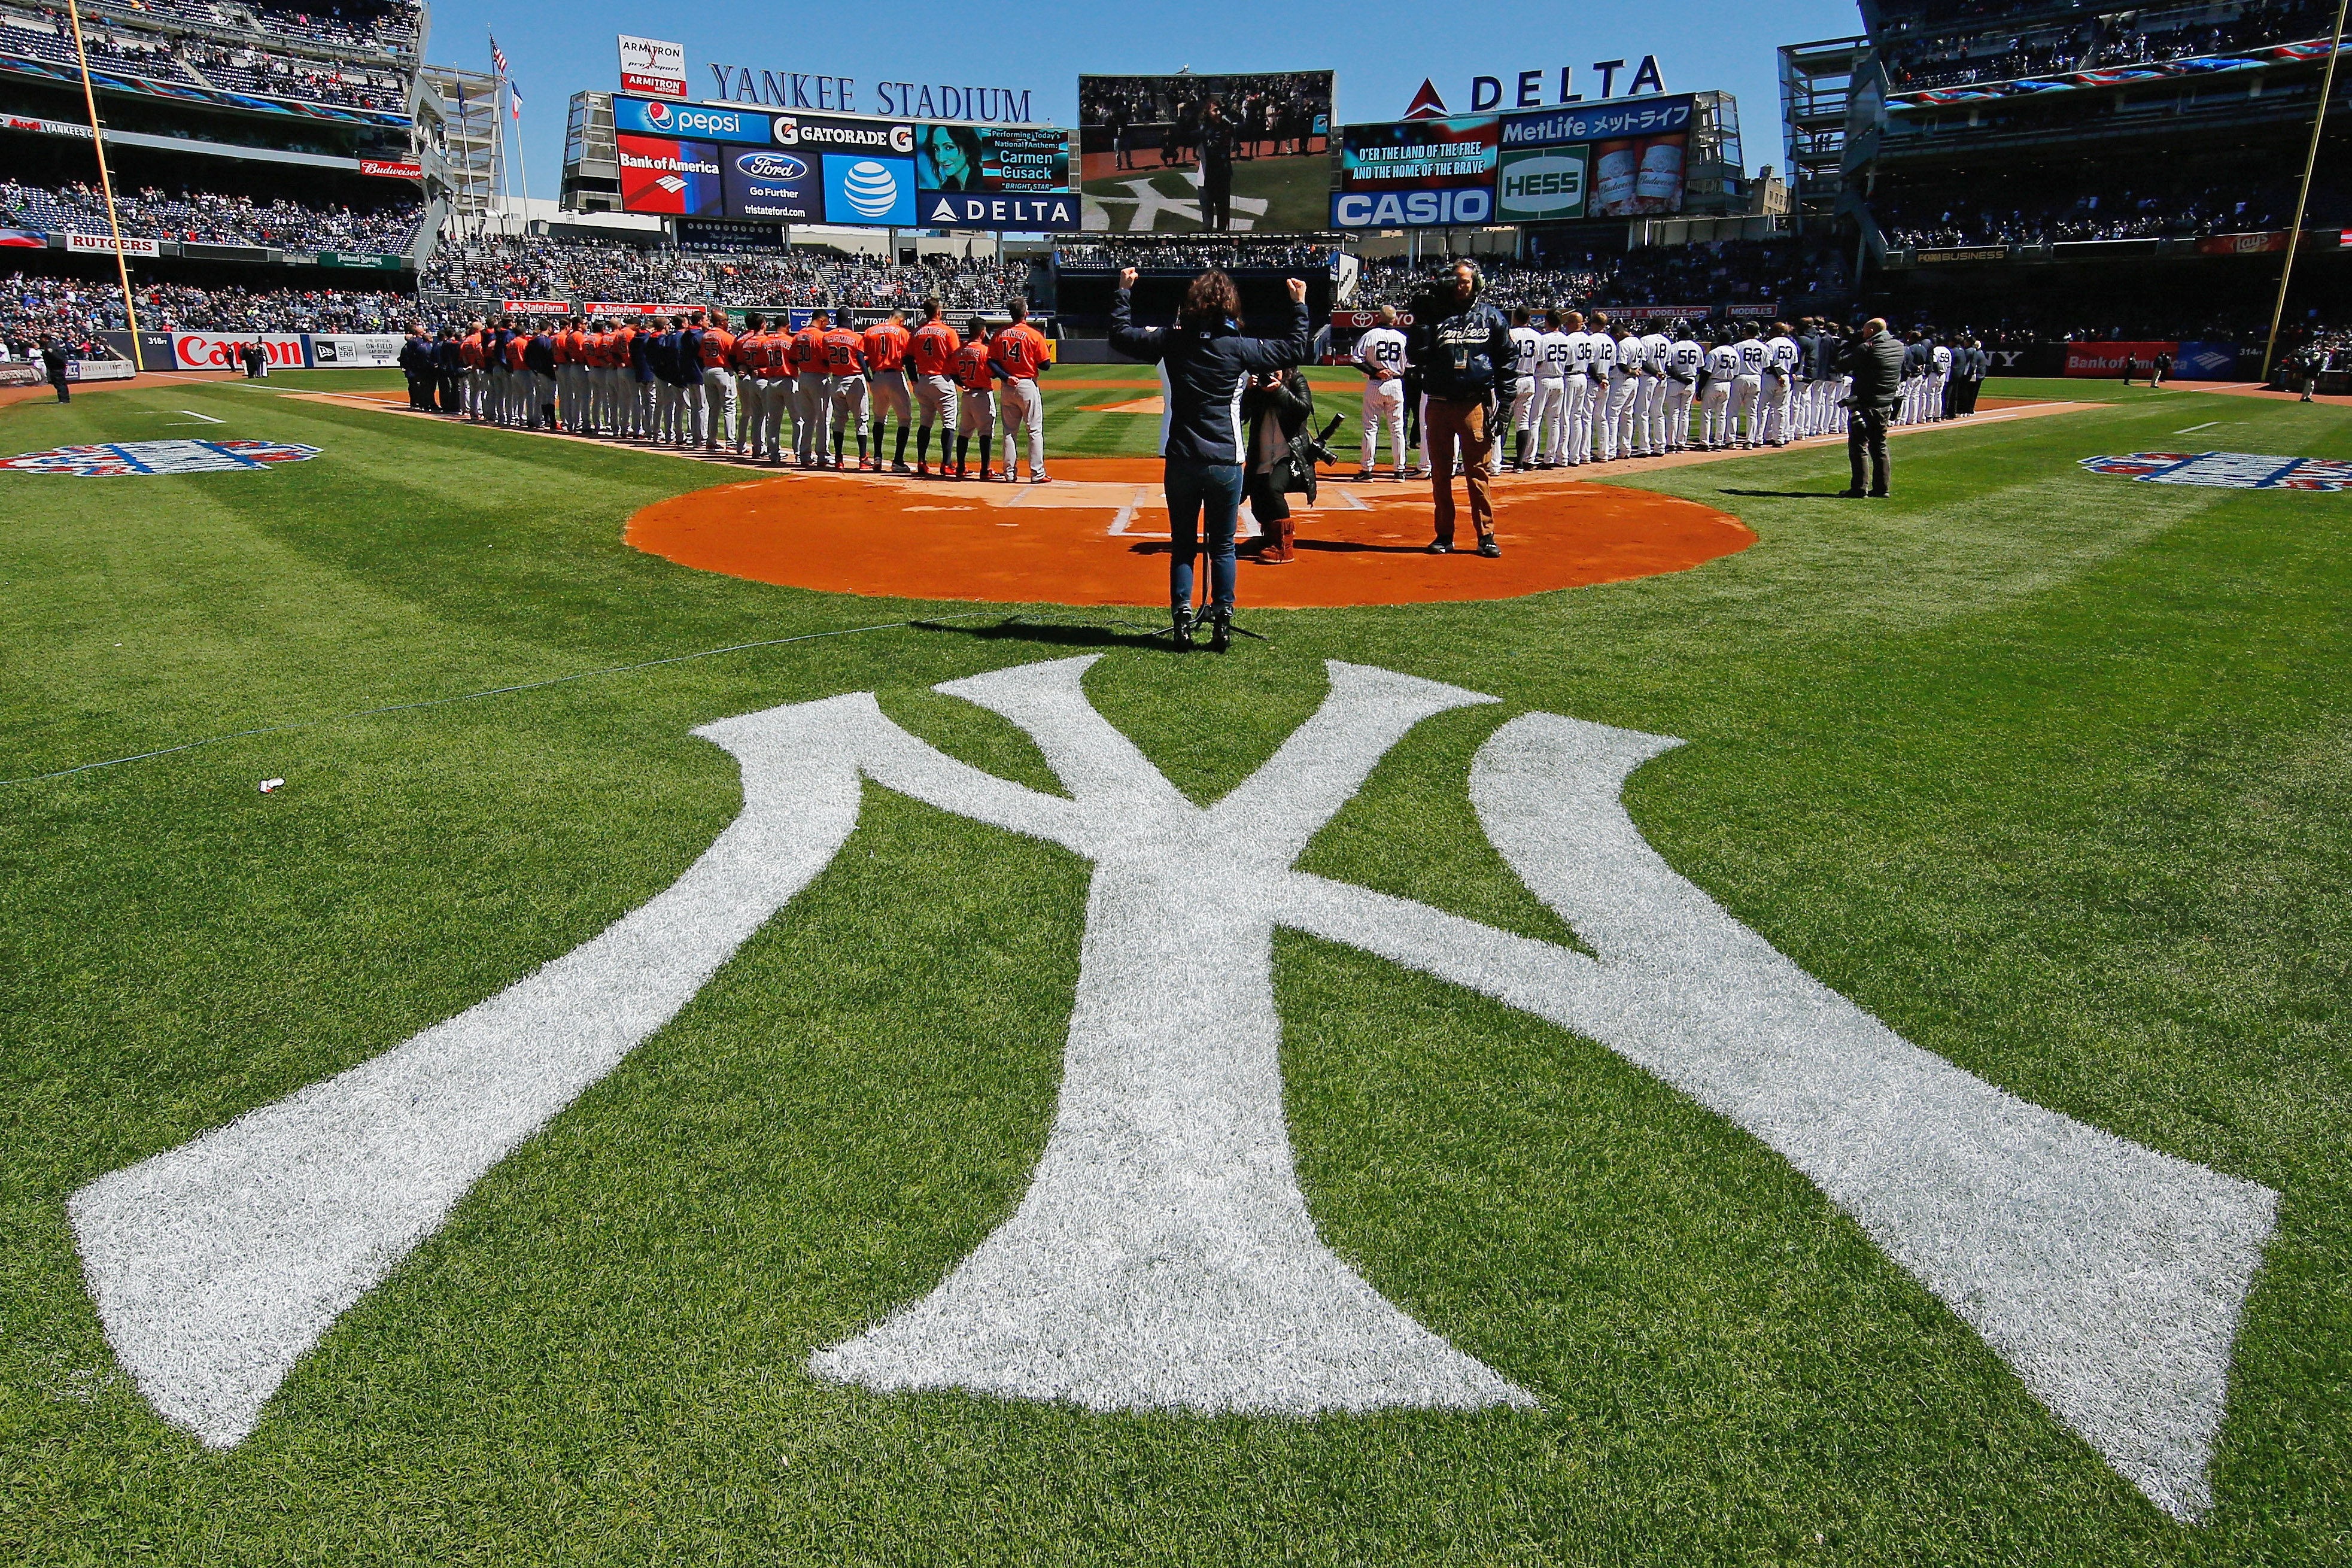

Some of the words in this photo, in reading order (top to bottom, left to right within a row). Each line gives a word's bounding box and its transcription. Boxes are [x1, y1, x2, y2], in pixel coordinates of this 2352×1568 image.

[623, 42, 680, 57] ARMITRON
[628, 75, 680, 89] ARMITRON
[1471, 54, 1666, 112] DELTA
[707, 63, 856, 112] YANKEE
[877, 81, 1031, 123] STADIUM
[9, 118, 42, 130] Audi
[44, 122, 85, 136] YANKEES
[87, 128, 110, 140] CUB
[678, 112, 740, 135] pepsi
[1502, 116, 1587, 142] MetLife
[1593, 106, 1689, 134] メットライフ
[800, 127, 887, 145] GATORADE
[992, 130, 1031, 139] Performing
[1034, 132, 1060, 140] Today's
[1000, 150, 1053, 164] Carmen
[1359, 147, 1380, 162] O'ER
[1381, 147, 1399, 160] THE
[1400, 145, 1425, 160] LAND
[1426, 144, 1438, 157] OF
[1440, 143, 1458, 157] THE
[1458, 141, 1481, 156] FREE
[361, 162, 421, 177] Budweiser
[619, 153, 654, 169] Bank
[654, 156, 668, 170] of
[668, 158, 719, 174] America
[750, 156, 794, 177] Ford
[1353, 167, 1372, 180] AND
[1374, 166, 1391, 179] THE
[1393, 164, 1420, 178] HOME
[1421, 163, 1433, 177] OF
[1435, 162, 1452, 176] THE
[1454, 160, 1484, 175] BRAVE
[1002, 166, 1052, 180] Cusack
[750, 187, 764, 196] Go
[765, 187, 798, 198] Further
[1505, 172, 1579, 197] HESS
[745, 205, 806, 217] tristateford.com
[967, 200, 1070, 221] DELTA
[1338, 190, 1489, 226] CASIO
[73, 236, 153, 251] RUTGERS
[337, 253, 360, 263] Poland
[360, 254, 382, 265] Spring
[1941, 251, 2004, 261] BUSINESS
[880, 335, 886, 354] 1
[923, 336, 932, 355] 4
[1002, 339, 1021, 363] 14
[1376, 341, 1402, 362] 28
[1517, 339, 1535, 358] 13
[1547, 344, 1567, 362] 25
[1577, 342, 1592, 360] 36
[1600, 343, 1612, 360] 12
[1654, 343, 1667, 359] 18
[1778, 345, 1793, 360] 63
[767, 350, 783, 367] 18
[828, 346, 850, 364] 28
[1678, 350, 1697, 365] 56
[1743, 347, 1763, 362] 62
[1940, 353, 1950, 363] 59
[2068, 356, 2108, 368] Bank
[2108, 356, 2125, 368] of
[959, 360, 977, 381] 27
